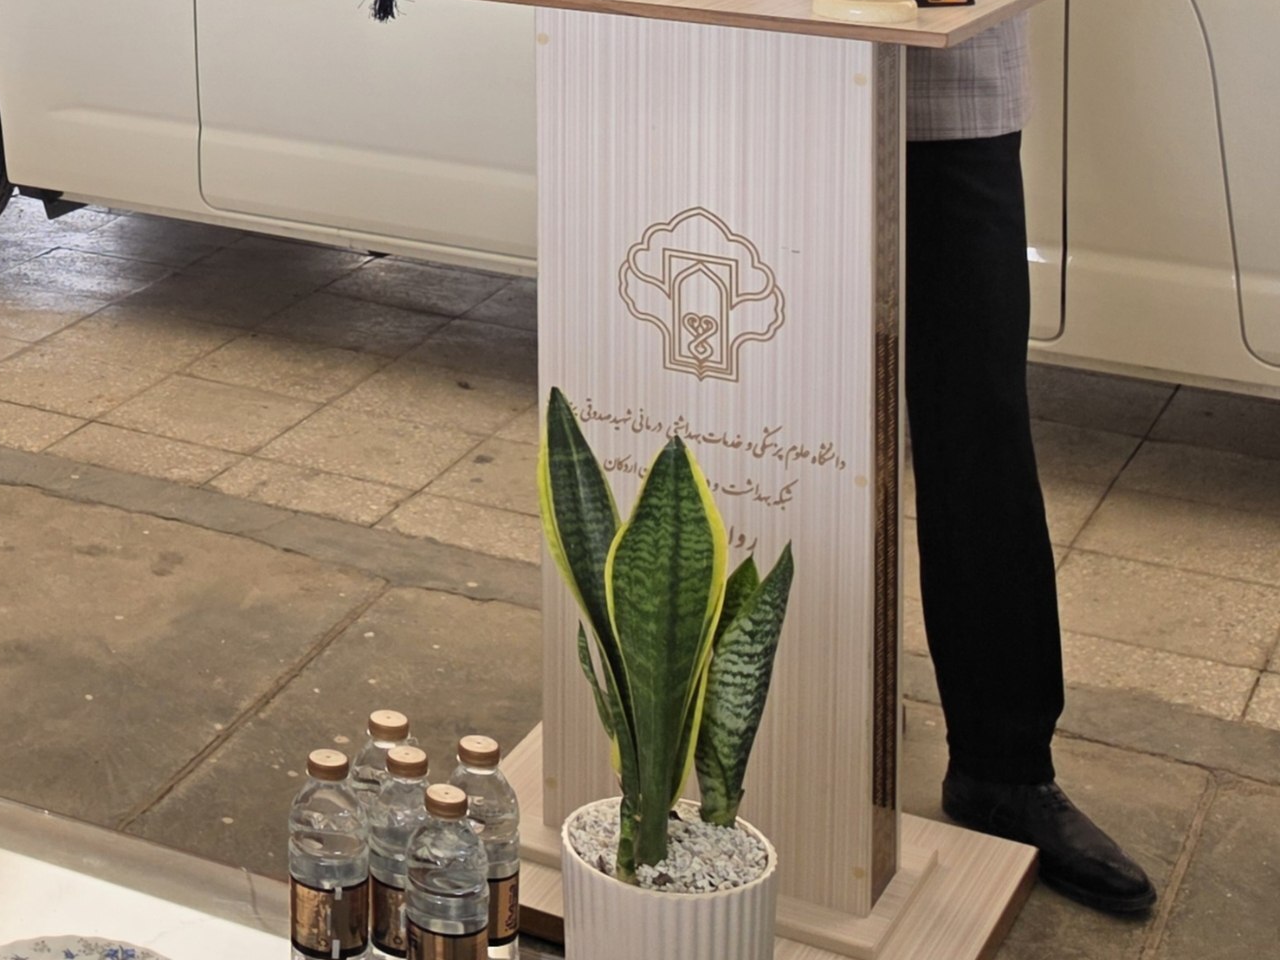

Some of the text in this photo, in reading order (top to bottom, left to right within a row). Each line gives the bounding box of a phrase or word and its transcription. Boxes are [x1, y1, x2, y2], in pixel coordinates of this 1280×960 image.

[609, 408, 632, 431] شهید
[631, 408, 662, 433] درمانی
[702, 432, 742, 449] خدمات
[745, 441, 753, 451] و
[752, 426, 783, 461] پزشکی
[603, 454, 637, 474] اردکان
[785, 443, 810, 470] علوم
[811, 442, 846, 470] دانشگاه
[712, 478, 799, 510] شبکه بهداشت و
